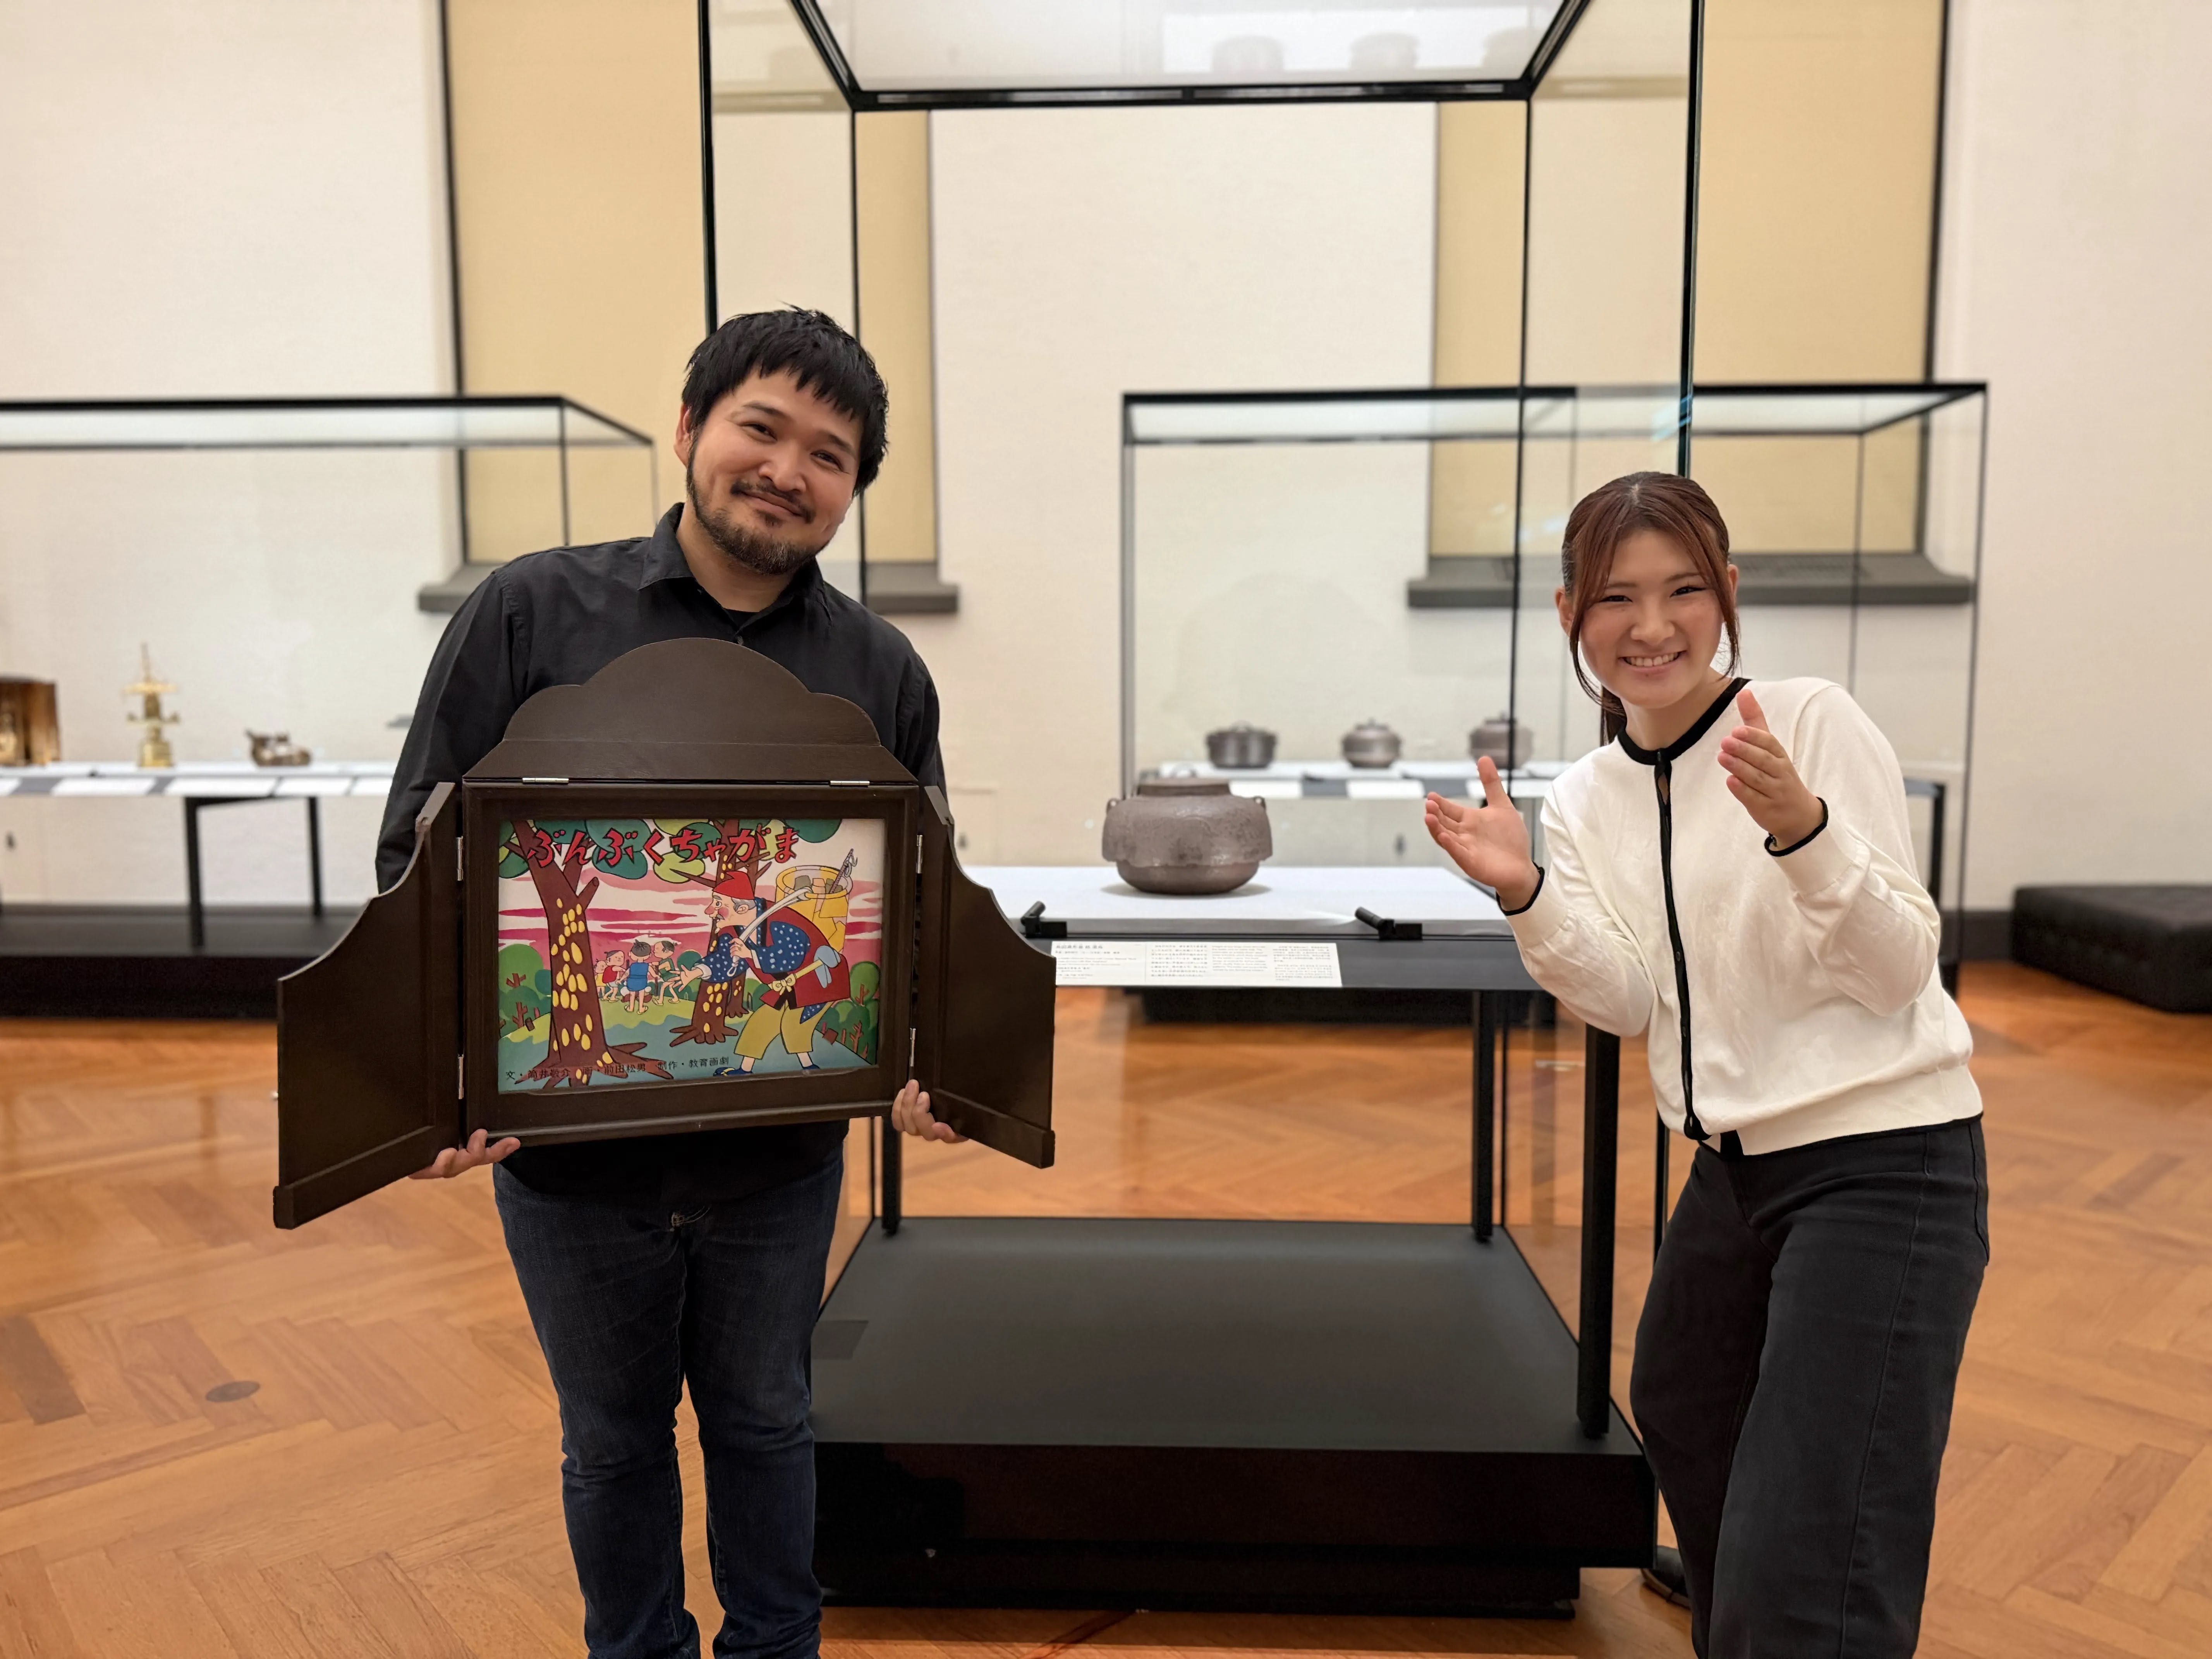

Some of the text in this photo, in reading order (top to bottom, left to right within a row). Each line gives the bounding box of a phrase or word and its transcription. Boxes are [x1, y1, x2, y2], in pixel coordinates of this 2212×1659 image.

[526, 824, 800, 868] ぶんぶくちゃがま
